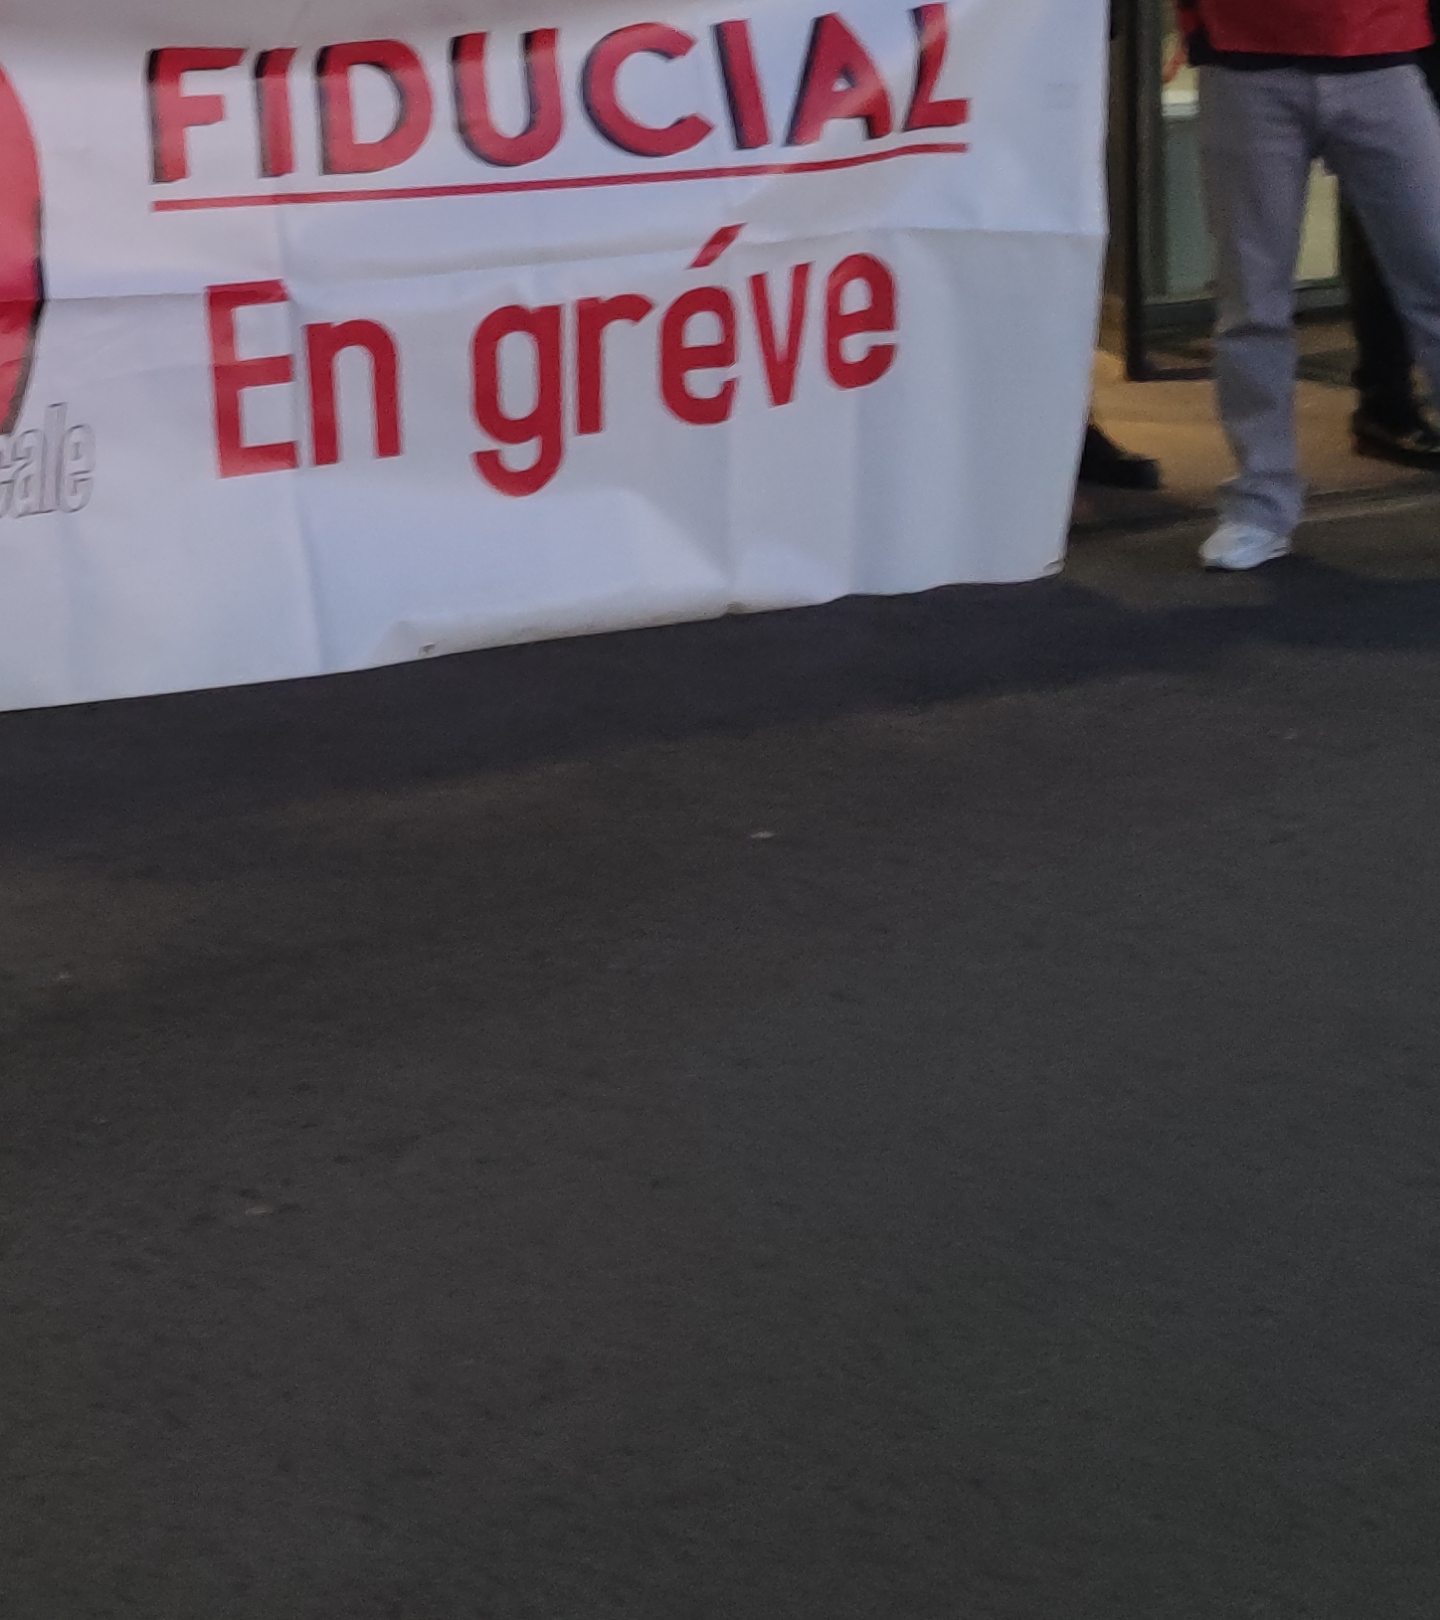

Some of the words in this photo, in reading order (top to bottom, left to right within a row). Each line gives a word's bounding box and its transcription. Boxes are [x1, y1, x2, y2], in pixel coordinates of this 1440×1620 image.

[148, 2, 972, 183] FIDUCIAL
[206, 279, 403, 480] En
[470, 224, 898, 497] gréve
